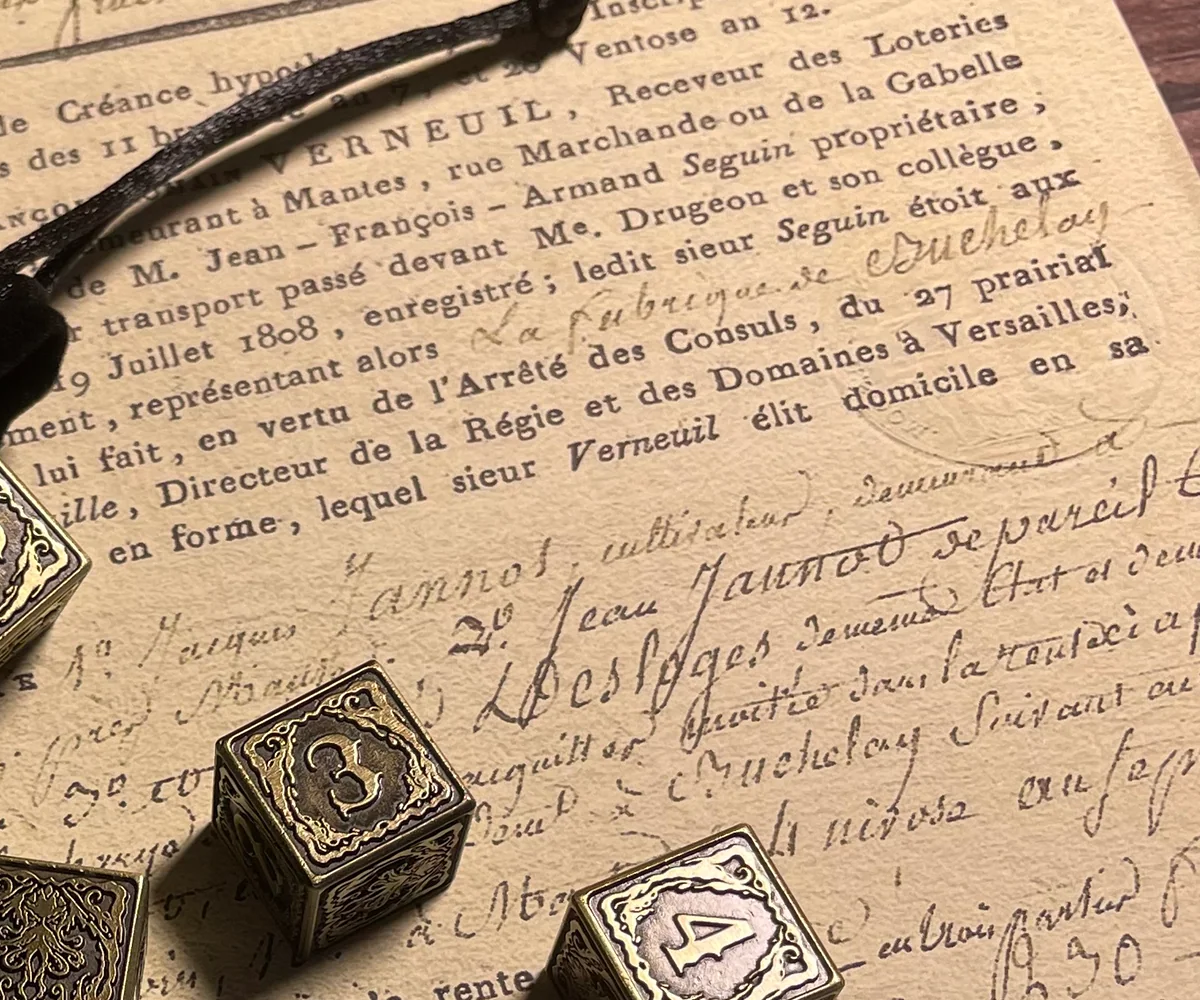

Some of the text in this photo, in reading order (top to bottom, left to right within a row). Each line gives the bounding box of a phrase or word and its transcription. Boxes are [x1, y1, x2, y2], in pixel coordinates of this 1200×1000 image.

[28, 143, 82, 171] des
[721, 14, 761, 36] an
[56, 83, 192, 124] Créance
[448, 156, 504, 181] rue
[519, 104, 717, 167] Marchande
[730, 99, 769, 129] ou
[785, 87, 825, 115] de
[844, 78, 874, 106] la
[885, 49, 1024, 96] Gabelle
[606, 61, 765, 109] Receveur
[788, 45, 843, 75] des
[864, 13, 1010, 60] Loteries
[67, 138, 795, 300] de M. Jean François Armand Seguin
[102, 286, 274, 338] transport
[277, 263, 367, 306] passé
[389, 239, 508, 278] devant
[619, 189, 767, 236] Drugeon
[783, 174, 817, 201] et
[828, 165, 884, 194] son
[108, 341, 214, 382] Juillet
[574, 249, 658, 285] ledit
[675, 231, 755, 267] sieur
[777, 207, 889, 250] Seguin
[908, 182, 989, 219] étoit
[1011, 168, 1081, 202] aux
[33, 458, 79, 488] lui
[198, 427, 238, 453] en
[259, 405, 352, 438] vertu
[372, 390, 414, 415] de
[588, 341, 646, 372] des
[839, 294, 885, 322] du
[915, 283, 954, 313] 27
[108, 542, 153, 566] en
[318, 474, 427, 528] lequel
[452, 458, 537, 496] sieur
[567, 415, 720, 473] Verneuil
[750, 402, 814, 432] élit
[843, 364, 999, 415] domicile
[1030, 352, 1076, 377] en
[1109, 332, 1149, 360] sa
[129, 339, 440, 423] représentant alors
[156, 338, 889, 510] Directeur de la Régie et des Domaines
[304, 733, 383, 822] 3
[660, 912, 756, 978] 4
